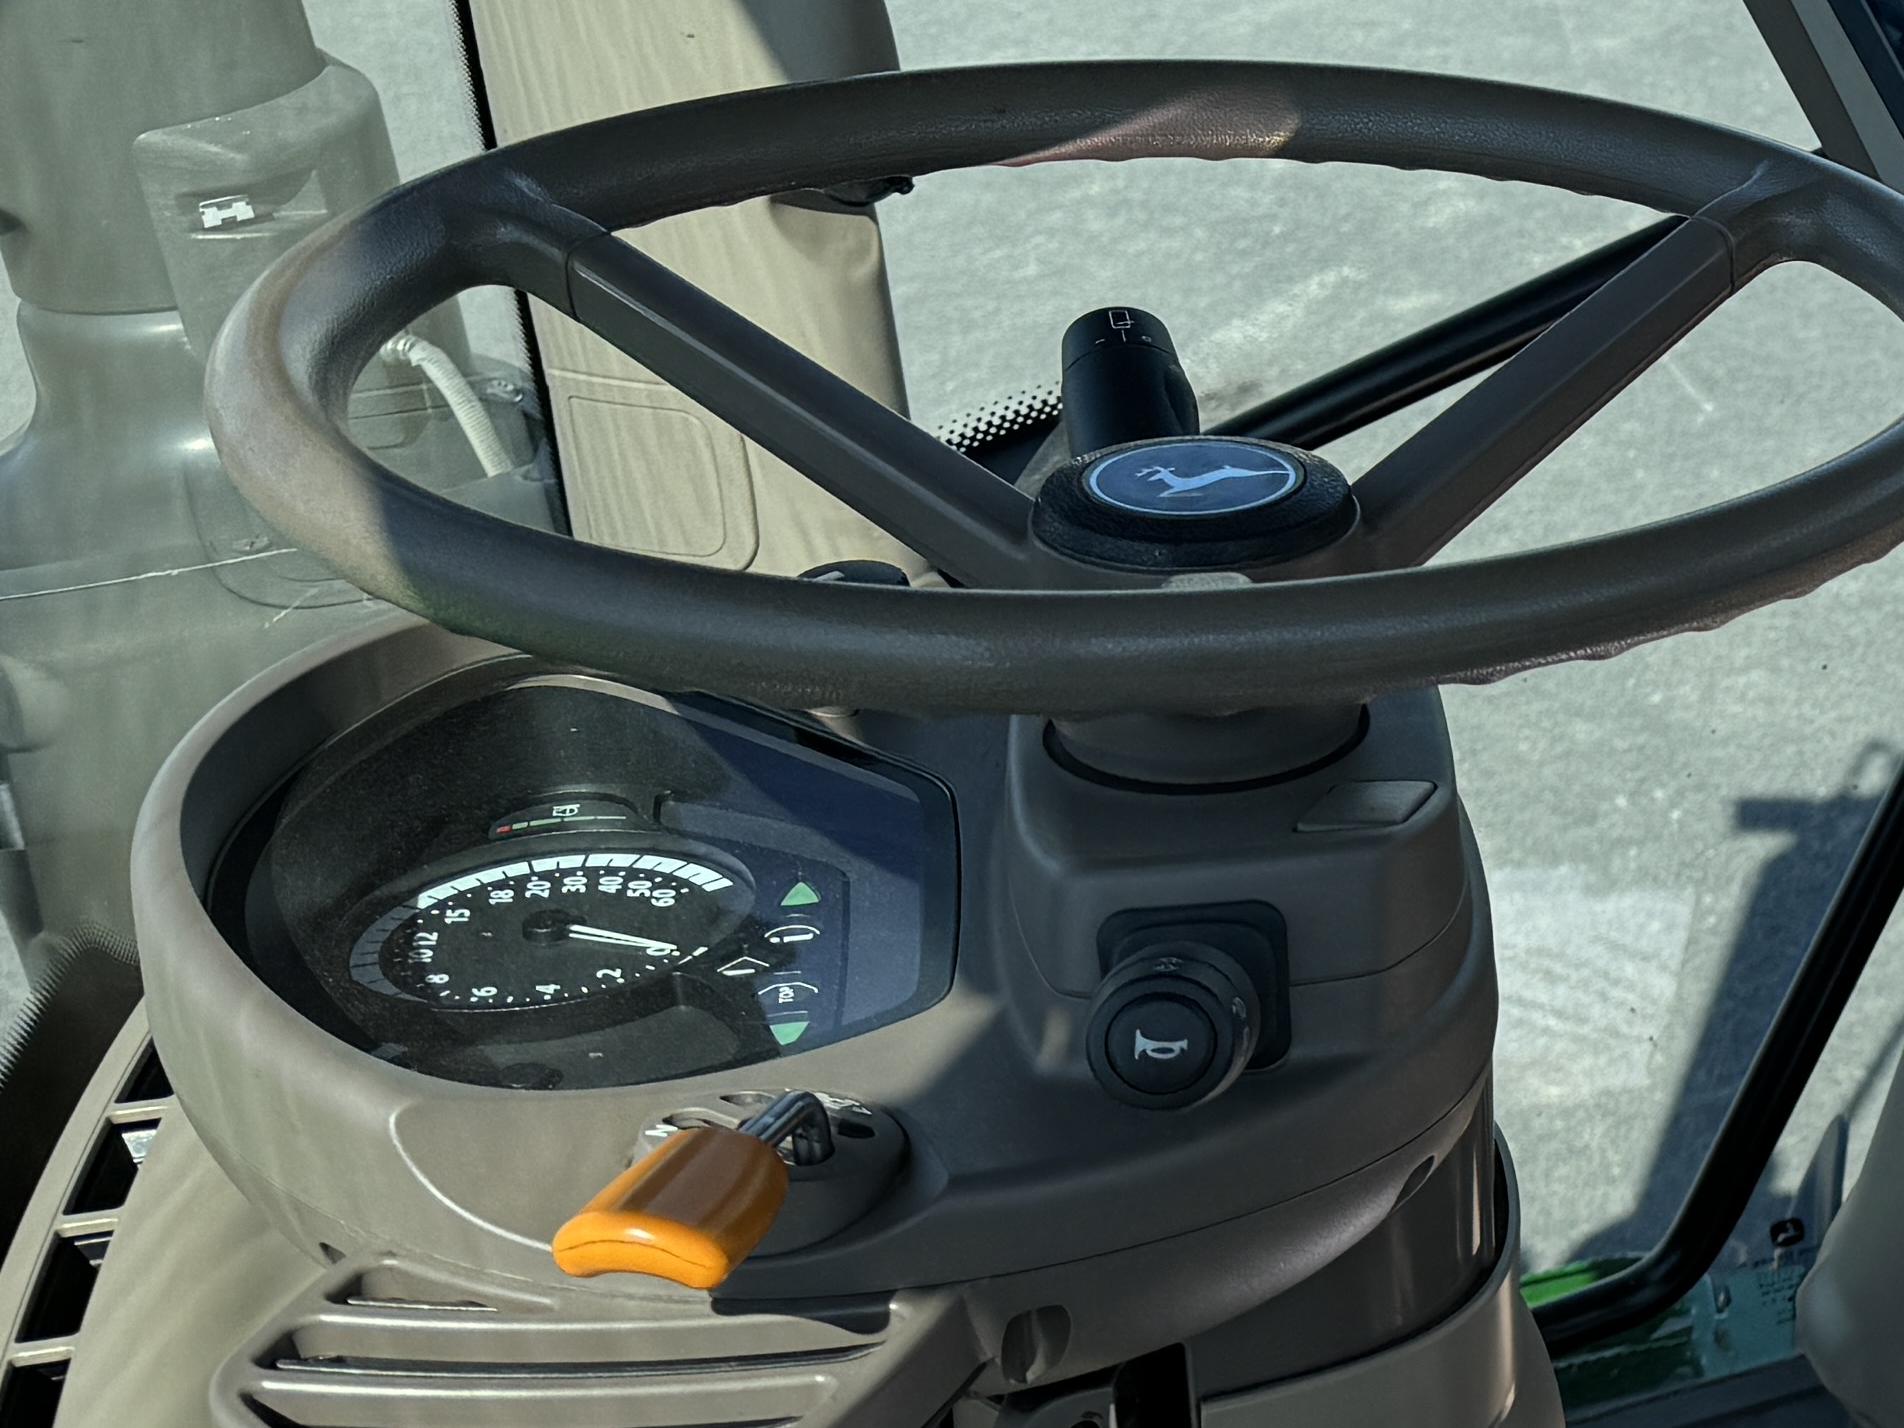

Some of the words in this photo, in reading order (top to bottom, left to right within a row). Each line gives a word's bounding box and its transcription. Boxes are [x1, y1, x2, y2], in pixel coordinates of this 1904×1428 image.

[525, 880, 551, 898] 20
[561, 876, 588, 894] 30
[598, 876, 624, 894] 40
[627, 880, 652, 897] 50
[488, 889, 515, 905] 18
[650, 888, 676, 907] 60
[444, 908, 471, 924] 15
[412, 931, 439, 946] 12
[408, 948, 434, 963] 10
[425, 973, 450, 984] 8
[596, 968, 622, 979] 2
[471, 986, 498, 996] 6
[535, 983, 561, 994] 4
